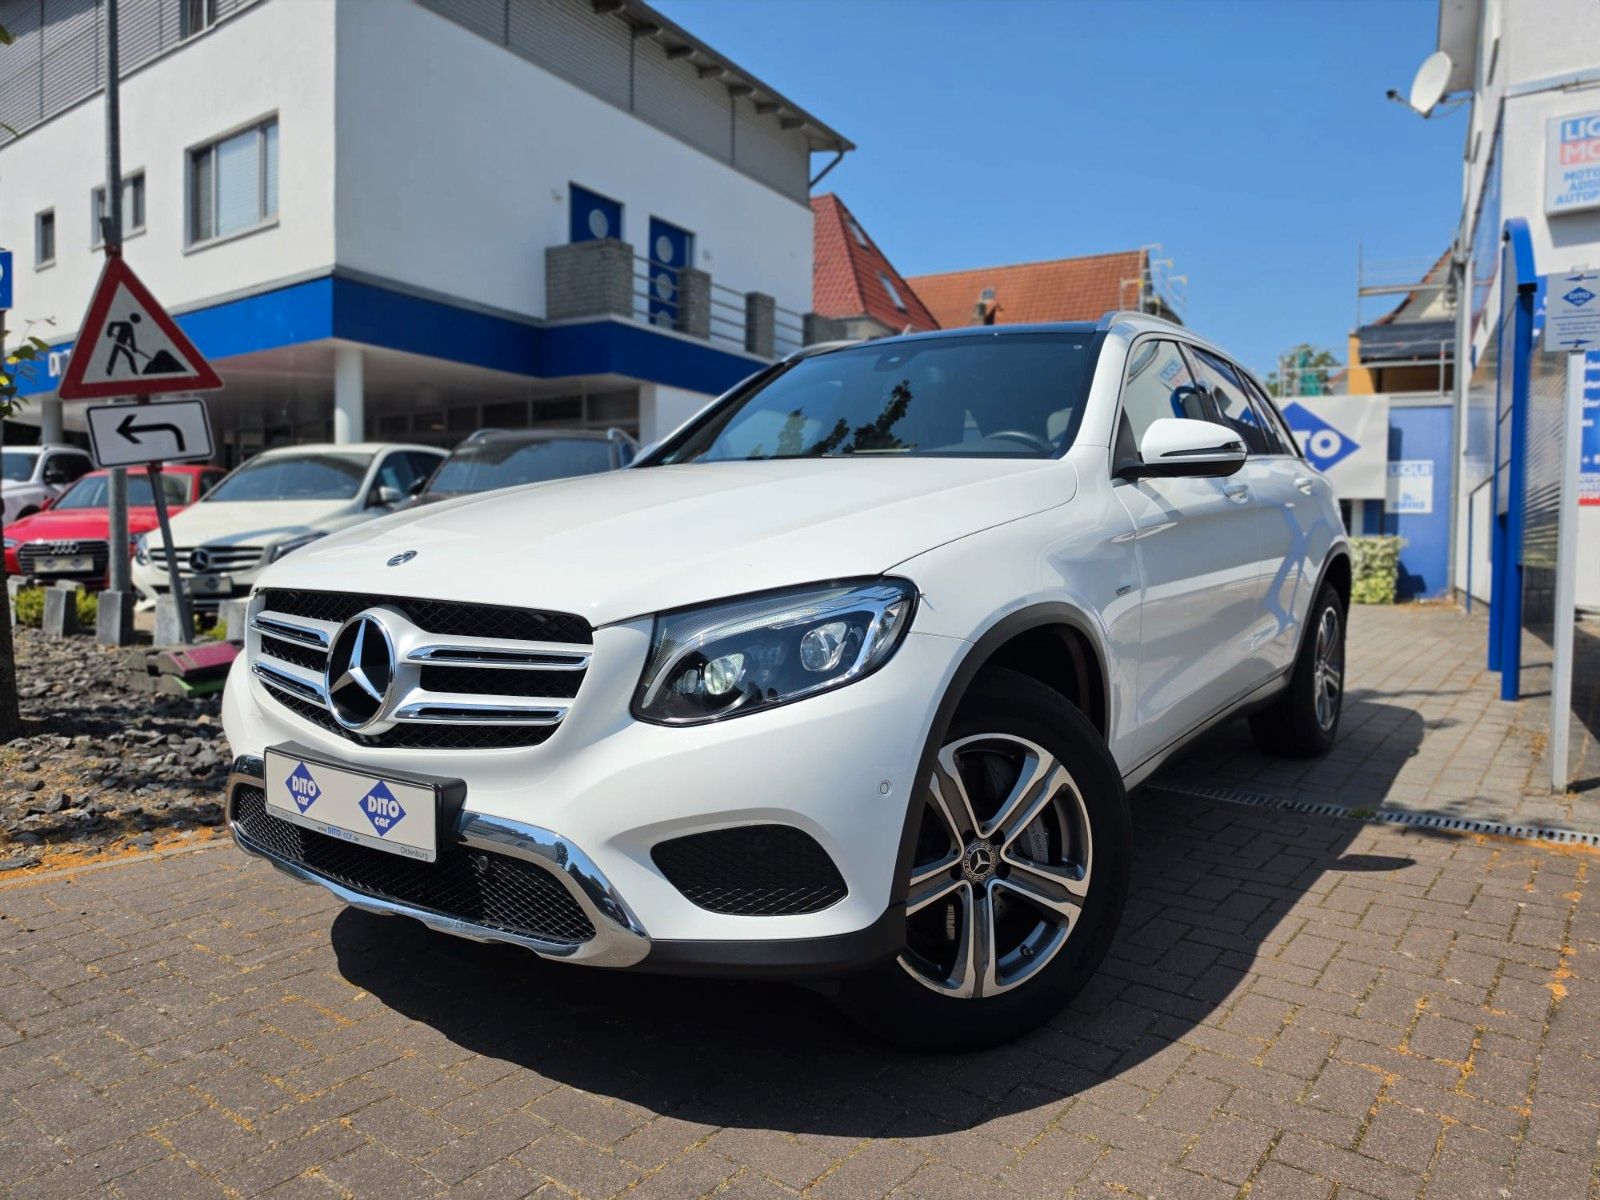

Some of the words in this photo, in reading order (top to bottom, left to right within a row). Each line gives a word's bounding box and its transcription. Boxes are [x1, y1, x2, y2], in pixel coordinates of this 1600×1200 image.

[1564, 140, 1600, 162] MO
[1563, 168, 1600, 181] MOTO
[1555, 190, 1600, 204] AUTOP
[1291, 429, 1342, 459] TO
[291, 775, 317, 797] DITO
[297, 795, 310, 806] car
[367, 795, 400, 818] DITO
[374, 816, 391, 829] car
